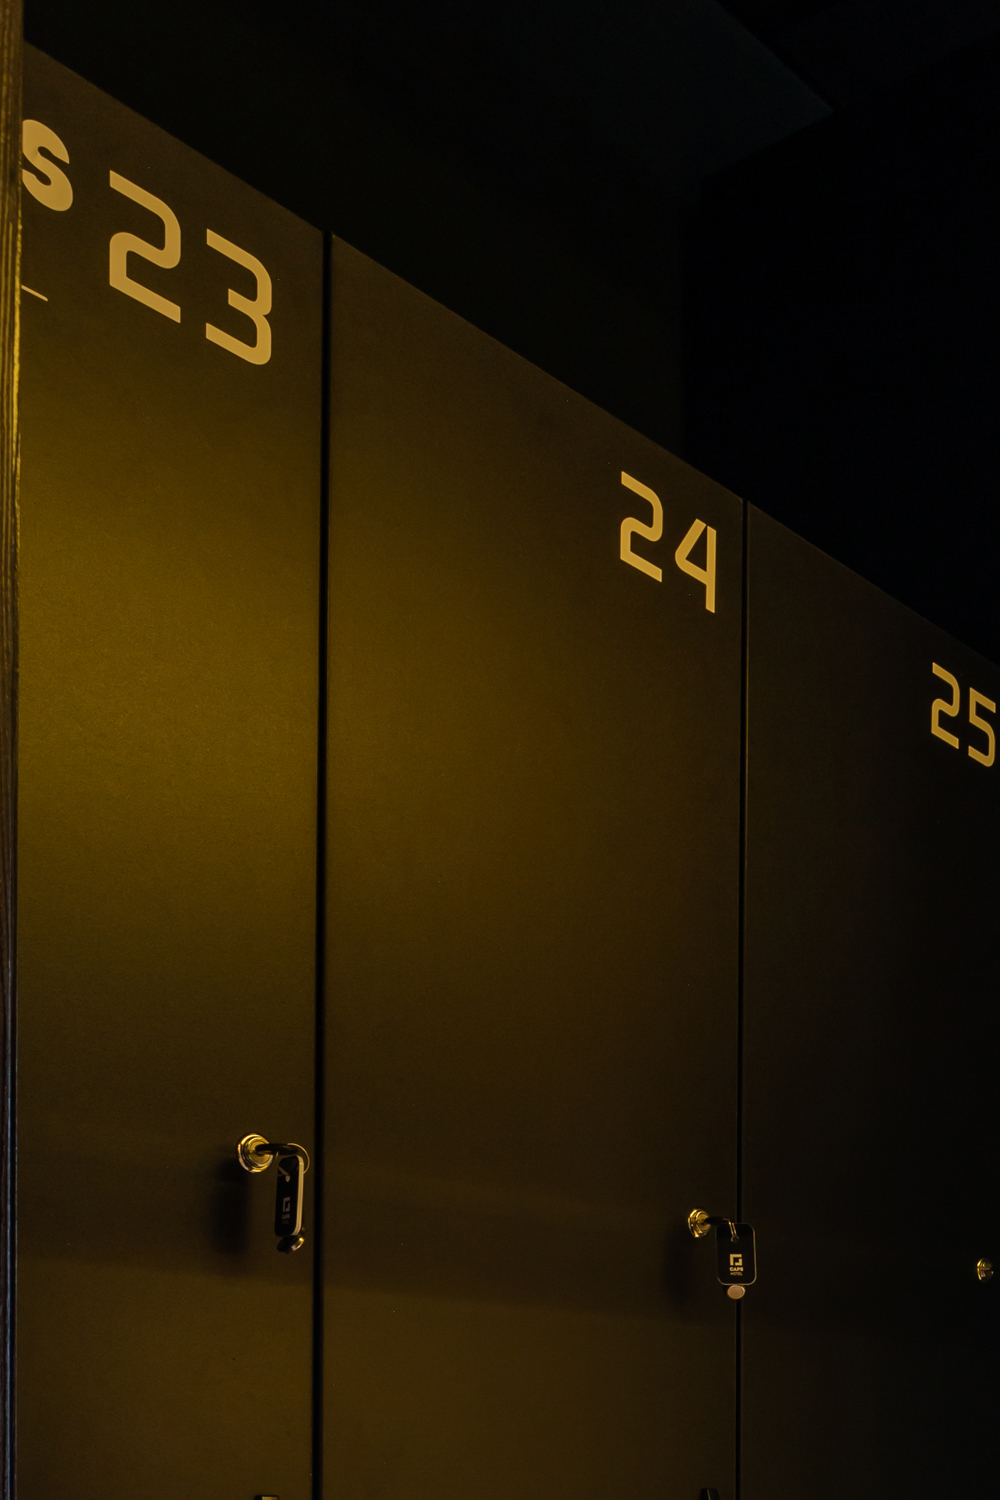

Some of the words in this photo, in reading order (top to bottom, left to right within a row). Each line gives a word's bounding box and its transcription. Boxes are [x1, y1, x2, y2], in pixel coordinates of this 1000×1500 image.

[109, 169, 272, 365] 23
[620, 471, 717, 614] 24
[931, 661, 996, 768] 25
